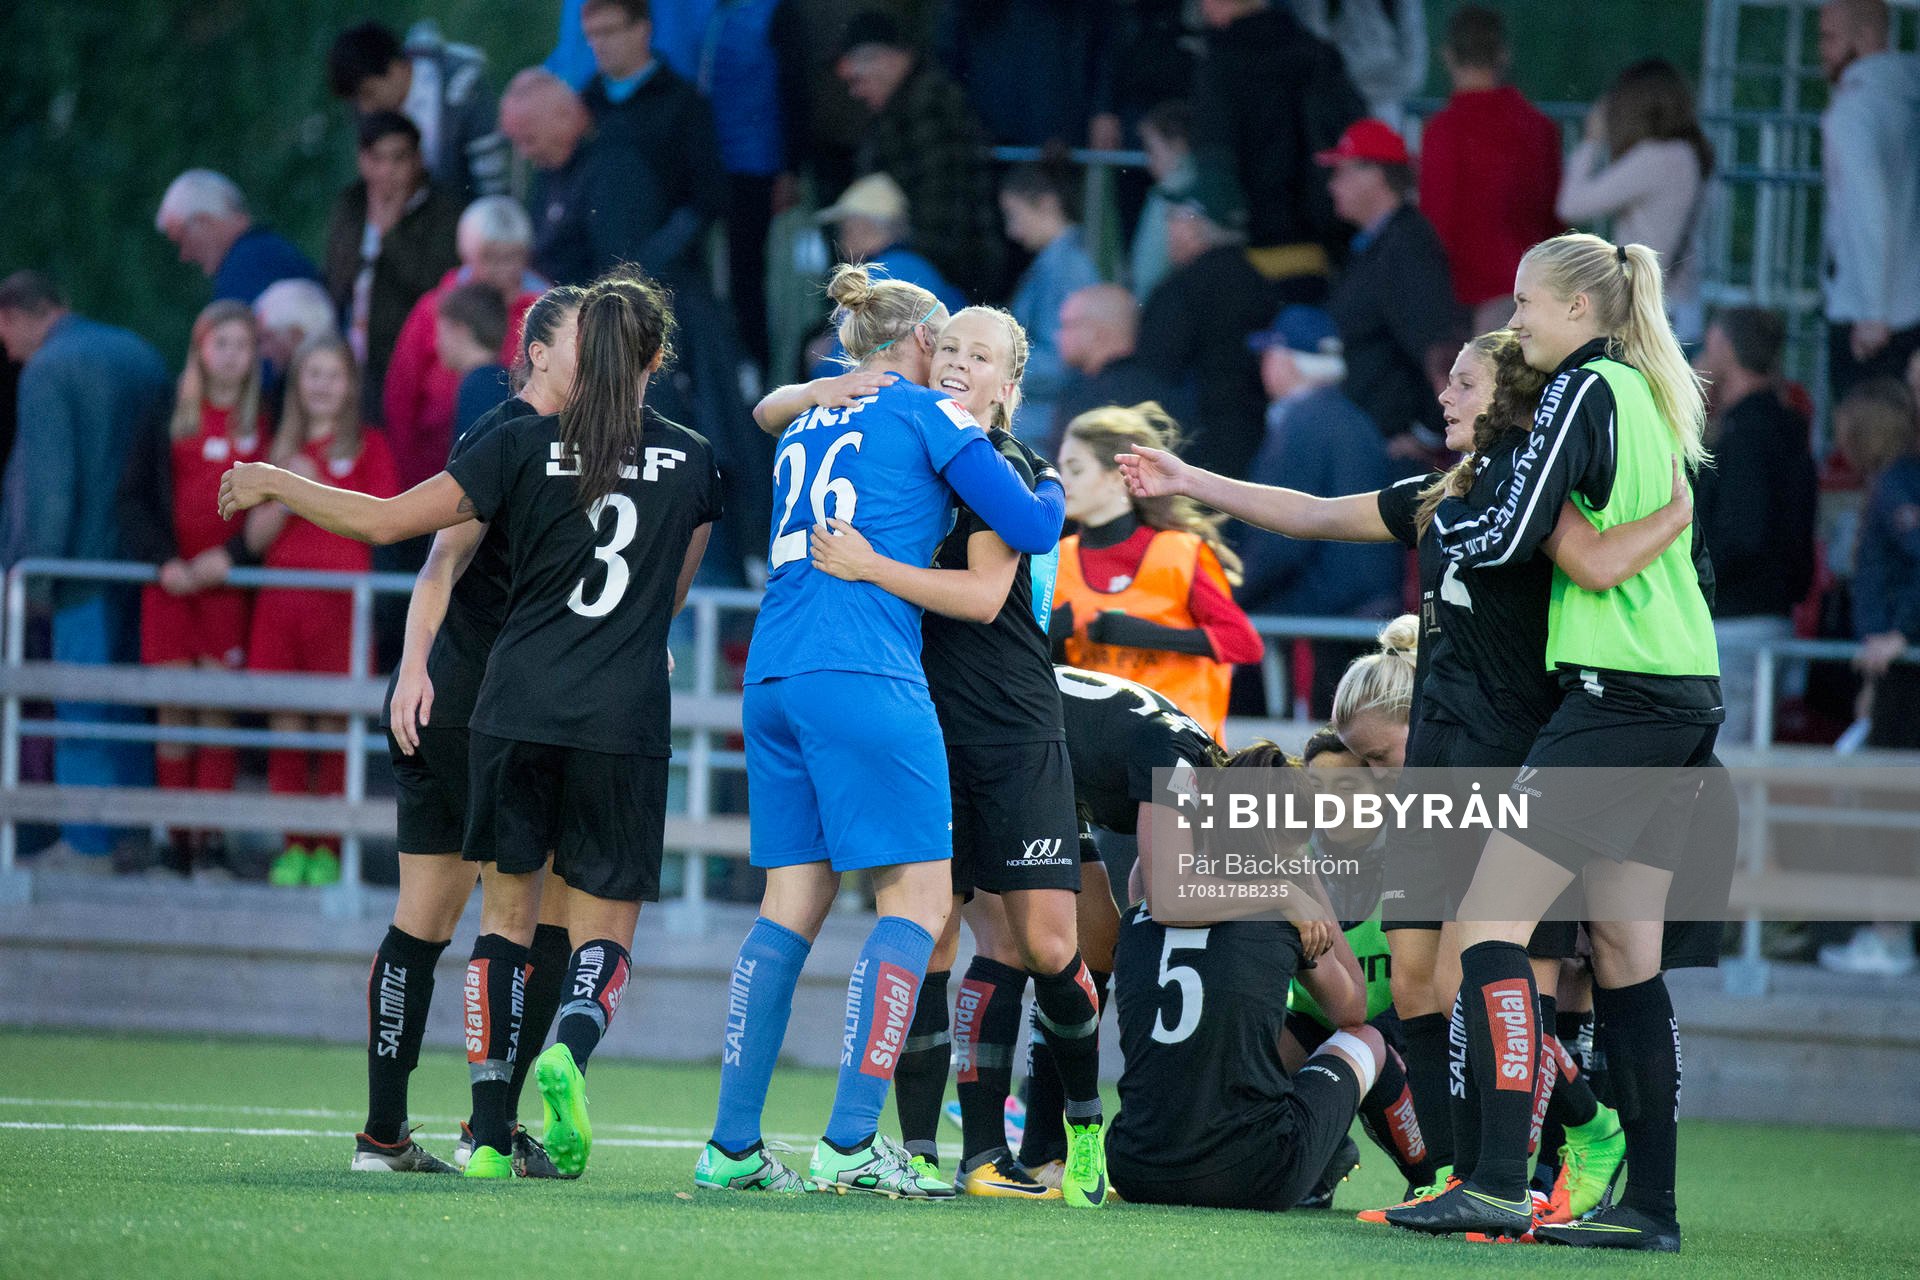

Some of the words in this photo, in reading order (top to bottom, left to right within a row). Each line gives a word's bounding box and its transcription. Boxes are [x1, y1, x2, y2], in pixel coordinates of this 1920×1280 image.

[546, 442, 687, 482] SF
[771, 431, 863, 570] 26
[567, 493, 638, 617] 3
[1039, 574, 1055, 632] ALMING
[377, 962, 407, 1059] SALMING
[464, 965, 482, 1053] Stavdal
[725, 957, 757, 1066] SALMING
[841, 958, 869, 1067] SALMING
[871, 974, 911, 1069] Stavdal
[1151, 927, 1212, 1045] 5
[1492, 989, 1528, 1080] Stavdal
[1529, 1043, 1556, 1143] Stavdal
